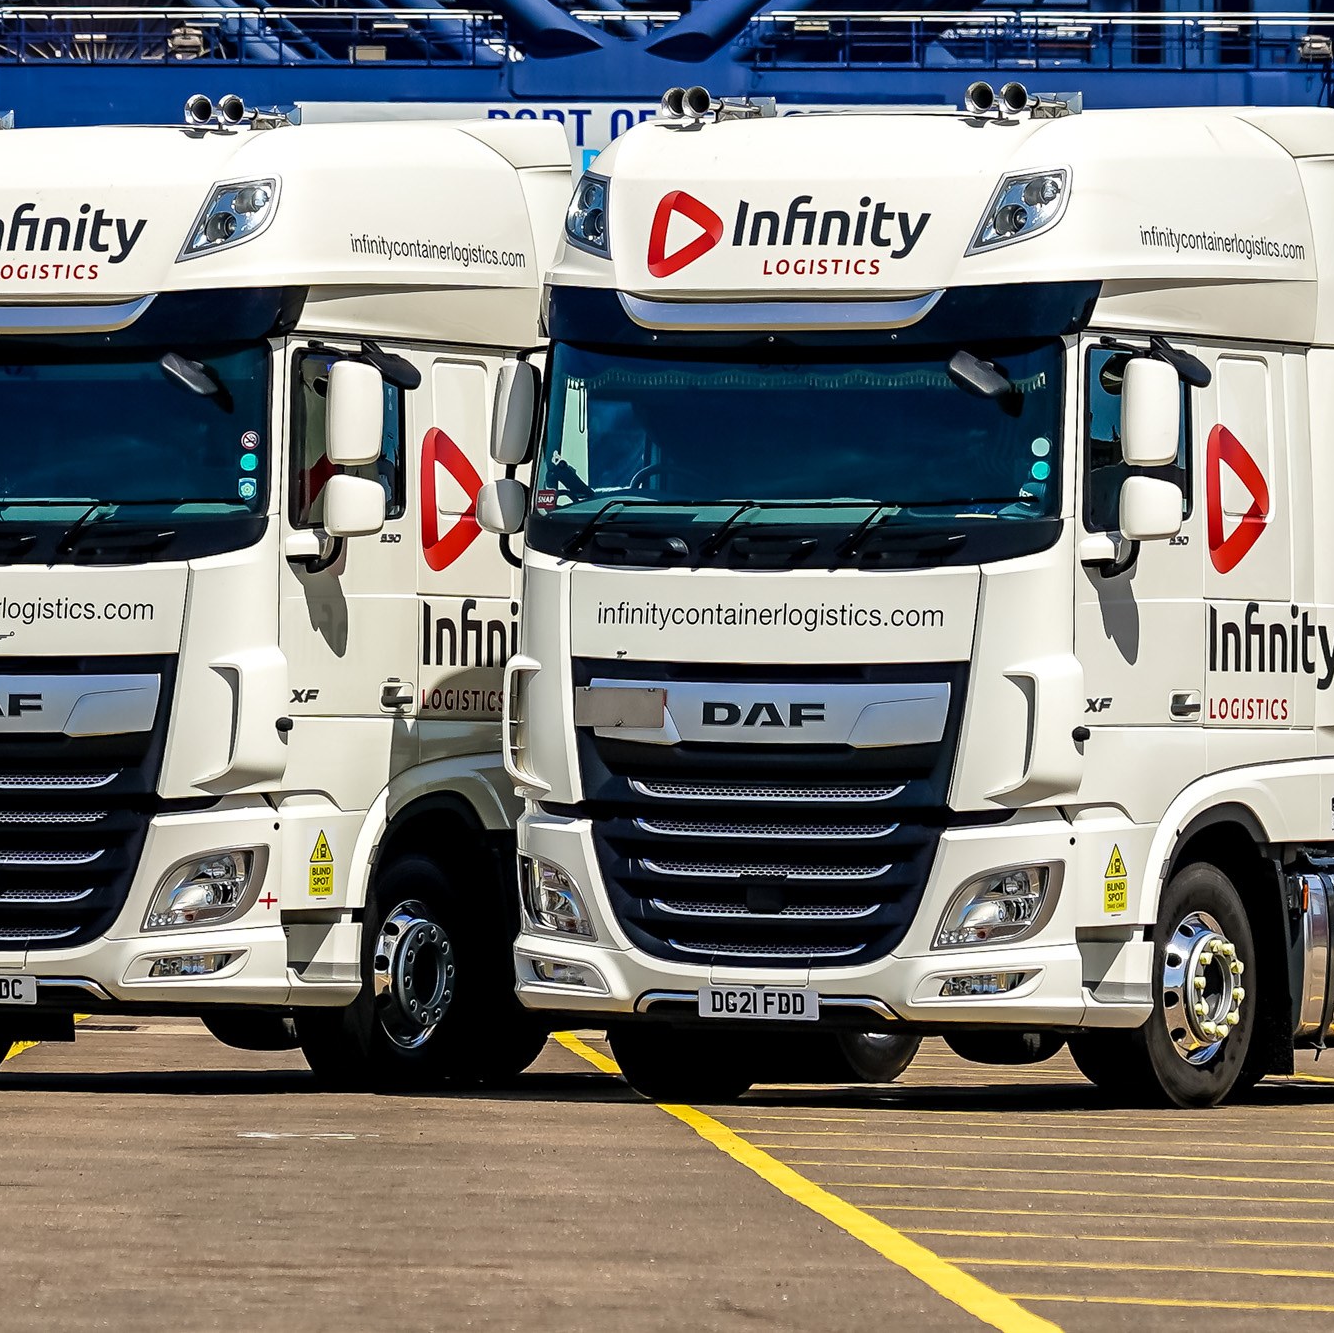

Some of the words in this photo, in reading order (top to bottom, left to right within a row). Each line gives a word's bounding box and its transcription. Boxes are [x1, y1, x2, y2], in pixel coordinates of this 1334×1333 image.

[732, 195, 932, 260] Infinity
[350, 233, 526, 268] infinitycontainerlogistics.com
[1139, 225, 1306, 261] infinitycontainerlogistics.com
[763, 259, 881, 276] LOGISTICS
[597, 601, 945, 632] infinitycontainerlogistics.com
[423, 598, 519, 668] Infini
[289, 689, 320, 704] XF
[1084, 697, 1113, 713] XF
[701, 701, 827, 728] DAF
[1209, 698, 1289, 720] LOGISTICS
[312, 867, 331, 875] BLIND
[313, 877, 329, 885] SPOT
[1107, 882, 1125, 891] BLIND
[1108, 892, 1124, 902] SPOT
[711, 991, 757, 1014] DG21
[763, 992, 805, 1015] FDD
